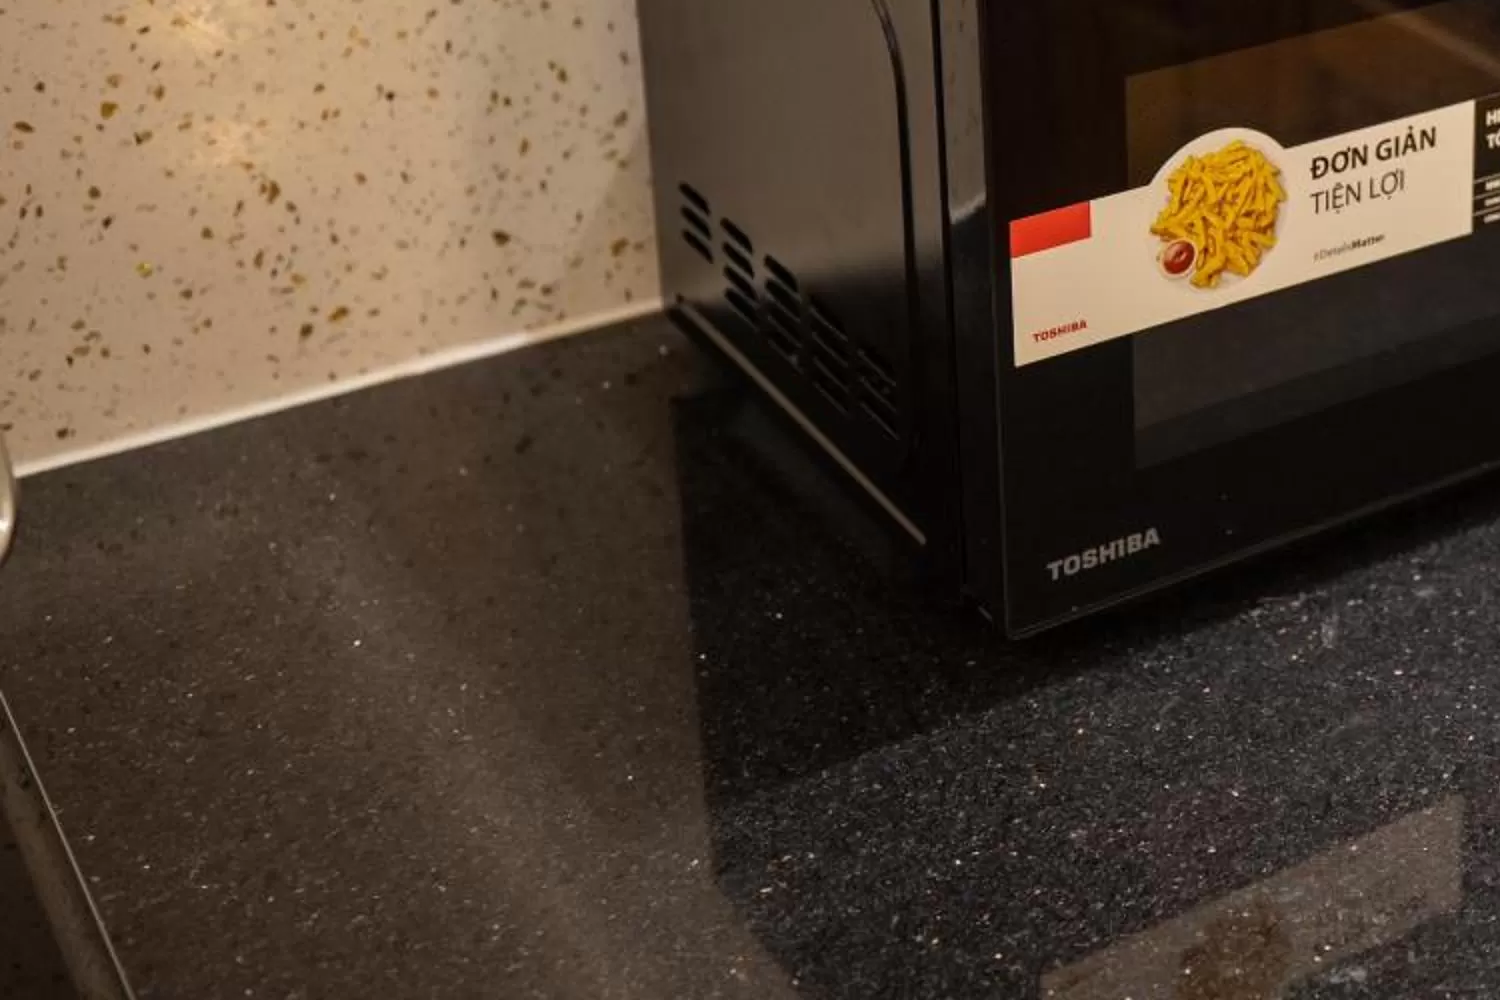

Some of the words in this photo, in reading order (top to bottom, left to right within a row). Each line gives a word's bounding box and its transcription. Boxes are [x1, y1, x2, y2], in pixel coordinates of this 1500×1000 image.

[1310, 144, 1369, 180] ĐƠN
[1375, 125, 1437, 161] GIẢN
[1310, 181, 1361, 215] TIỆN
[1369, 167, 1405, 201] LỢI
[1032, 319, 1087, 343] TOSHIBA
[1046, 527, 1161, 581] TOSHIBA
